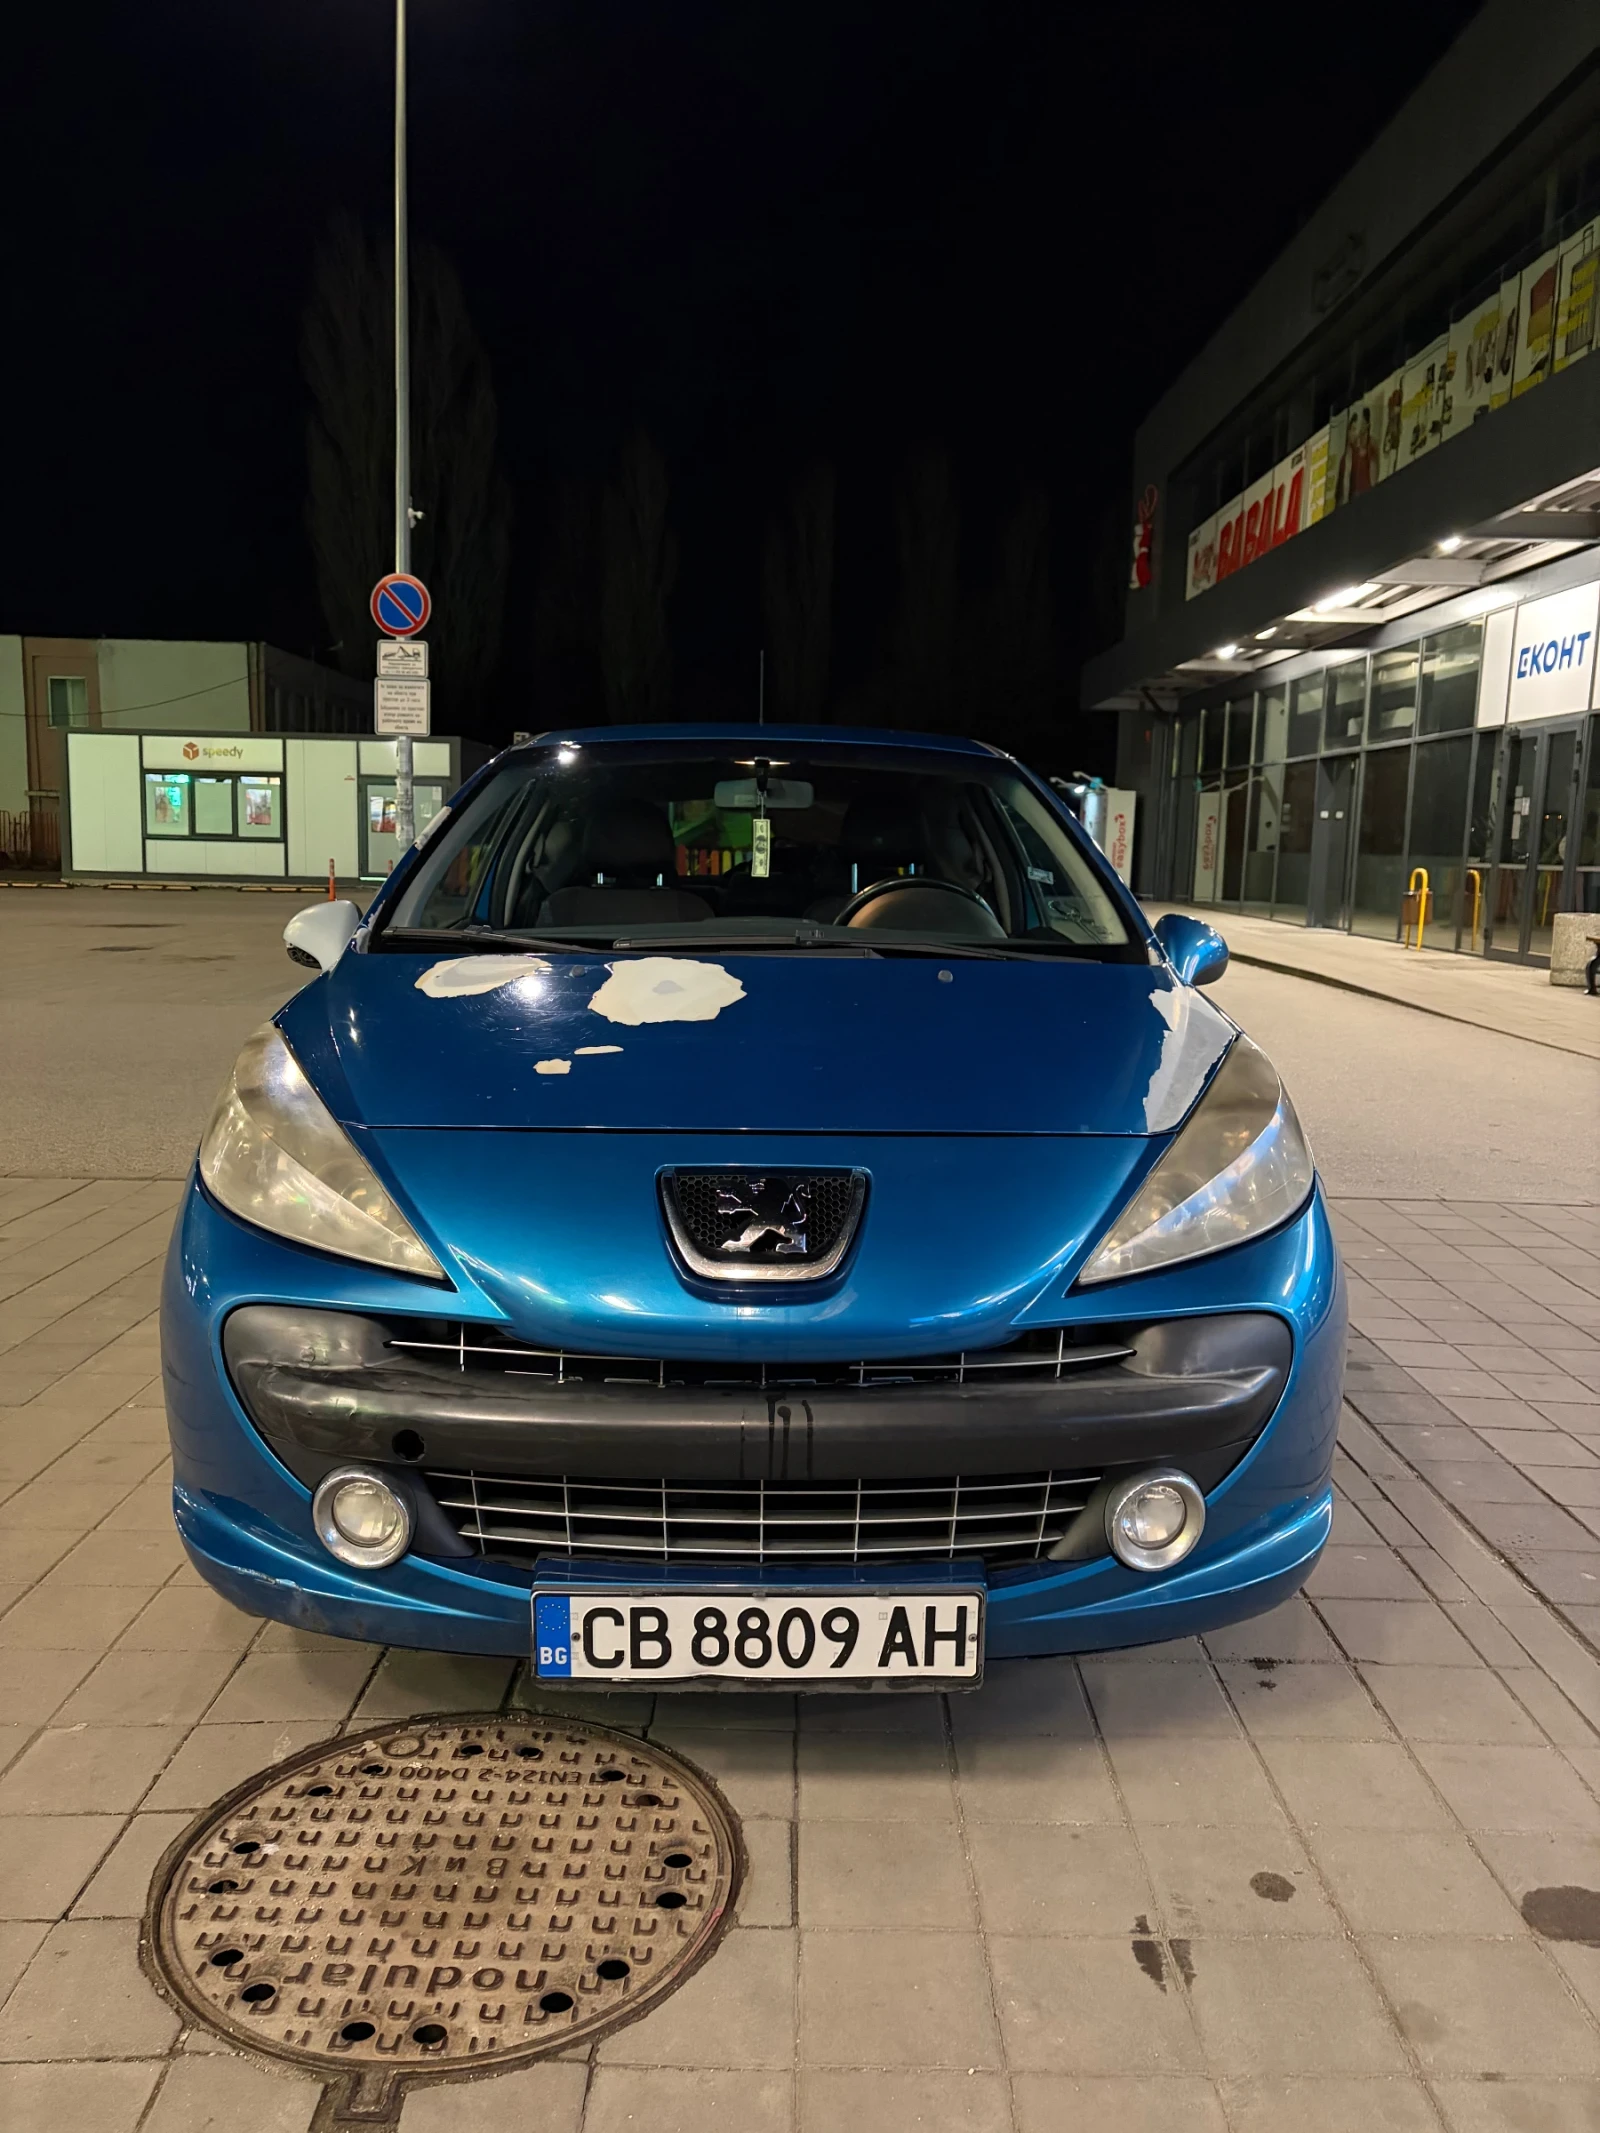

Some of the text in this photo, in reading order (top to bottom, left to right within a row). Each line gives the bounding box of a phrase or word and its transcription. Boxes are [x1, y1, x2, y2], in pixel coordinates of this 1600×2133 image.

[1517, 631, 1591, 679] ЕКОНТ
[203, 746, 243, 759] speedy
[1116, 821, 1127, 868] easybox
[582, 1605, 968, 1669] CB 8809 AH
[540, 1646, 568, 1665] BG
[400, 1766, 469, 1782] D400
[283, 1961, 548, 1995] nodular
